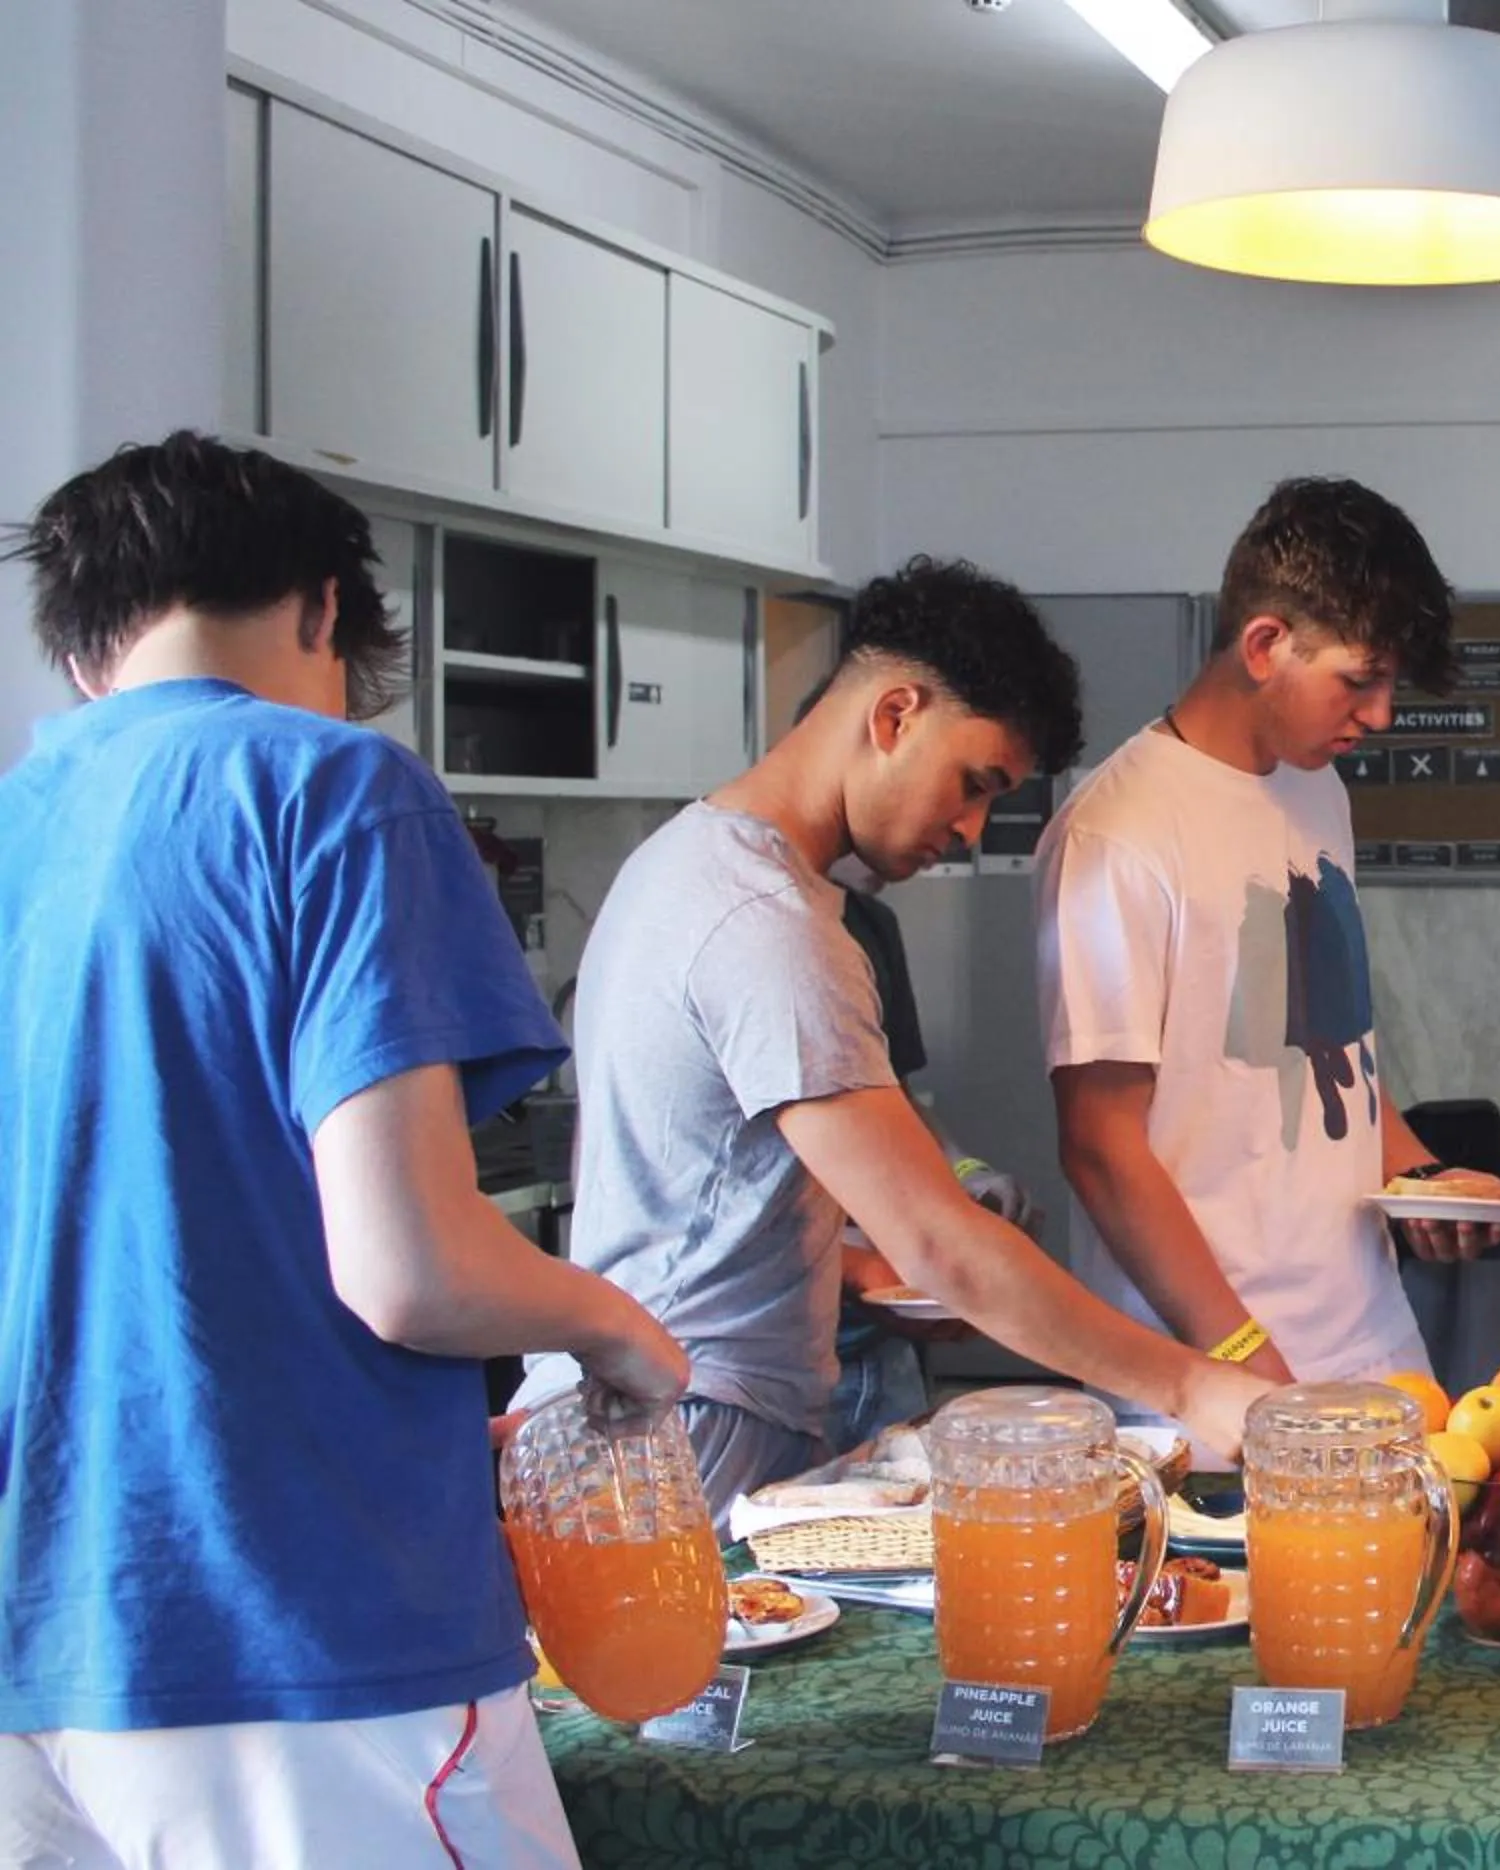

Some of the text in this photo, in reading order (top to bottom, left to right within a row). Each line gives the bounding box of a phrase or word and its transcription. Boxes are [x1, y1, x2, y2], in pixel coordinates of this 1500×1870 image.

[1395, 712, 1485, 727] ACTIVITIES
[954, 1686, 1037, 1707] PINEAPPLE
[1250, 1701, 1320, 1715] ORANGE
[969, 1709, 1014, 1725] JUICE
[1261, 1720, 1309, 1733] JUICE
